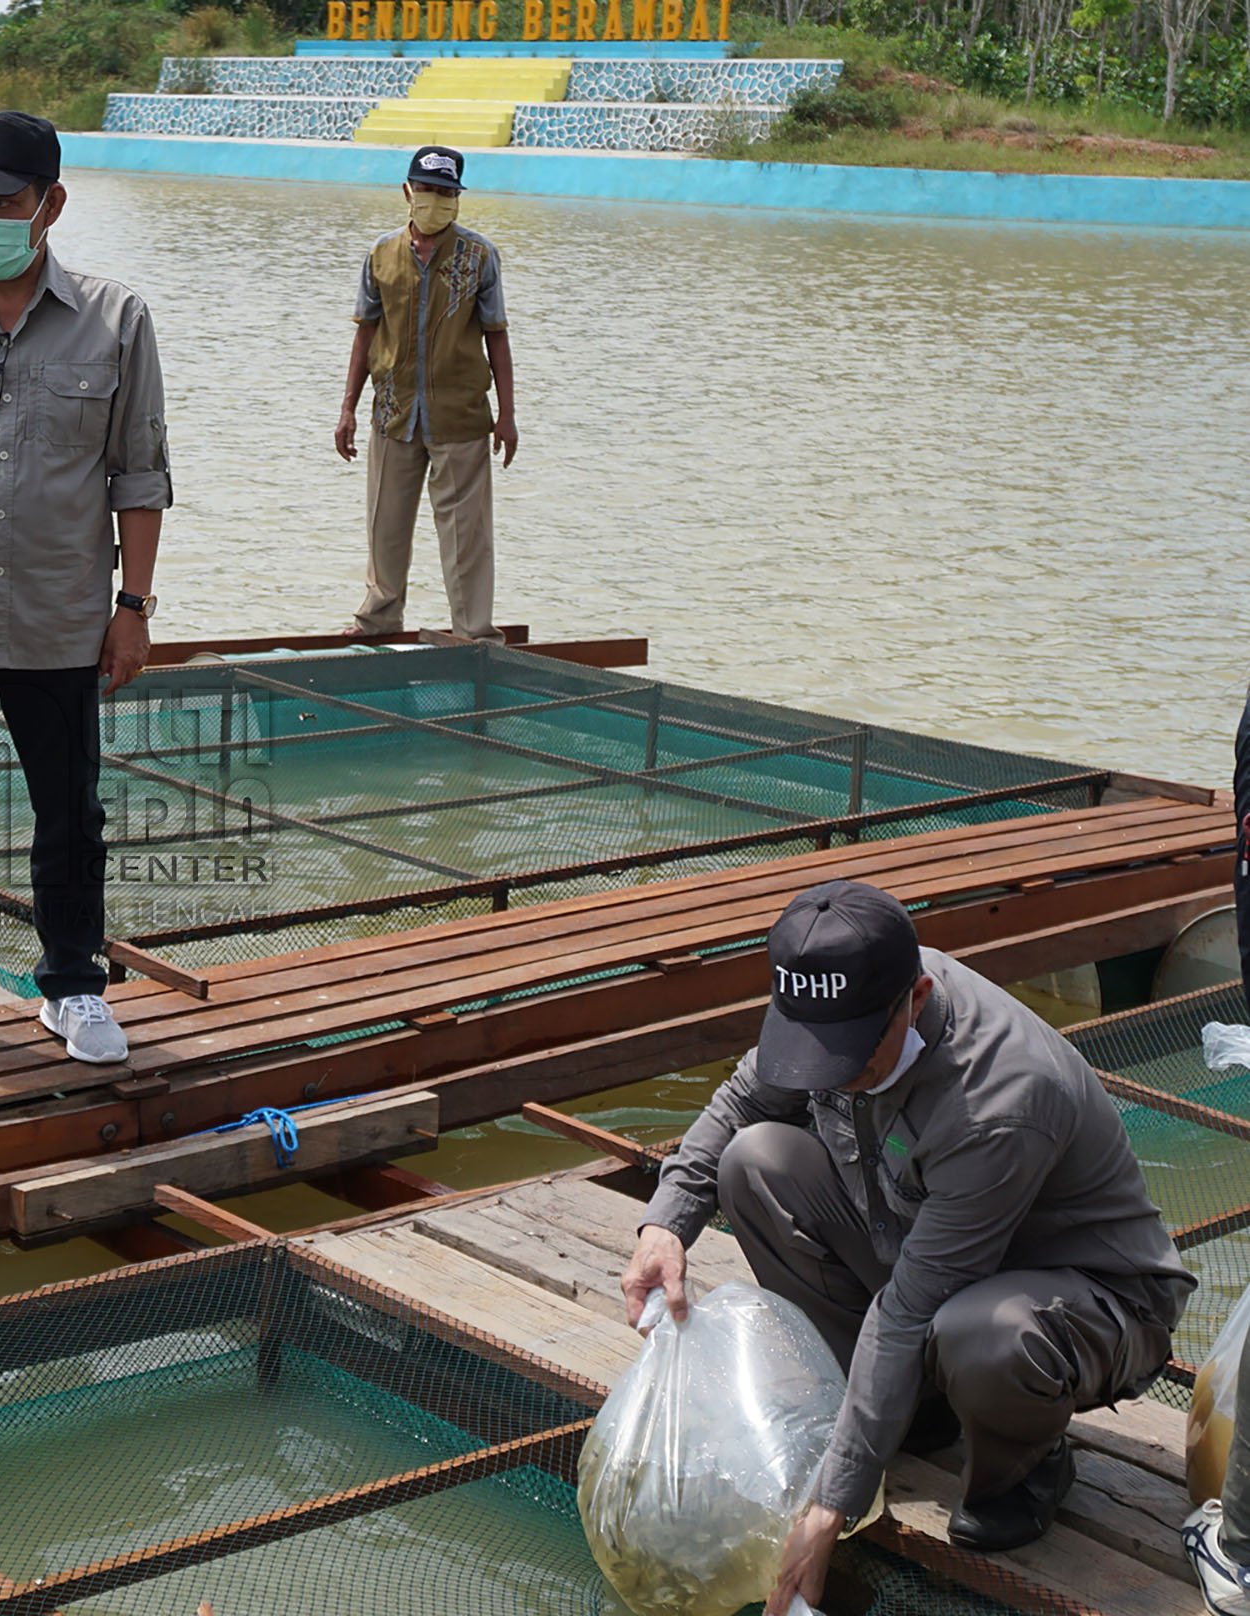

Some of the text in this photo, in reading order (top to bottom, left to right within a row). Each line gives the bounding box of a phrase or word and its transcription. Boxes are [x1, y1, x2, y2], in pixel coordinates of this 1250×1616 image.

[327, 0, 730, 41] BENDUNG BERAMBAI
[775, 965, 847, 999] TPHP
